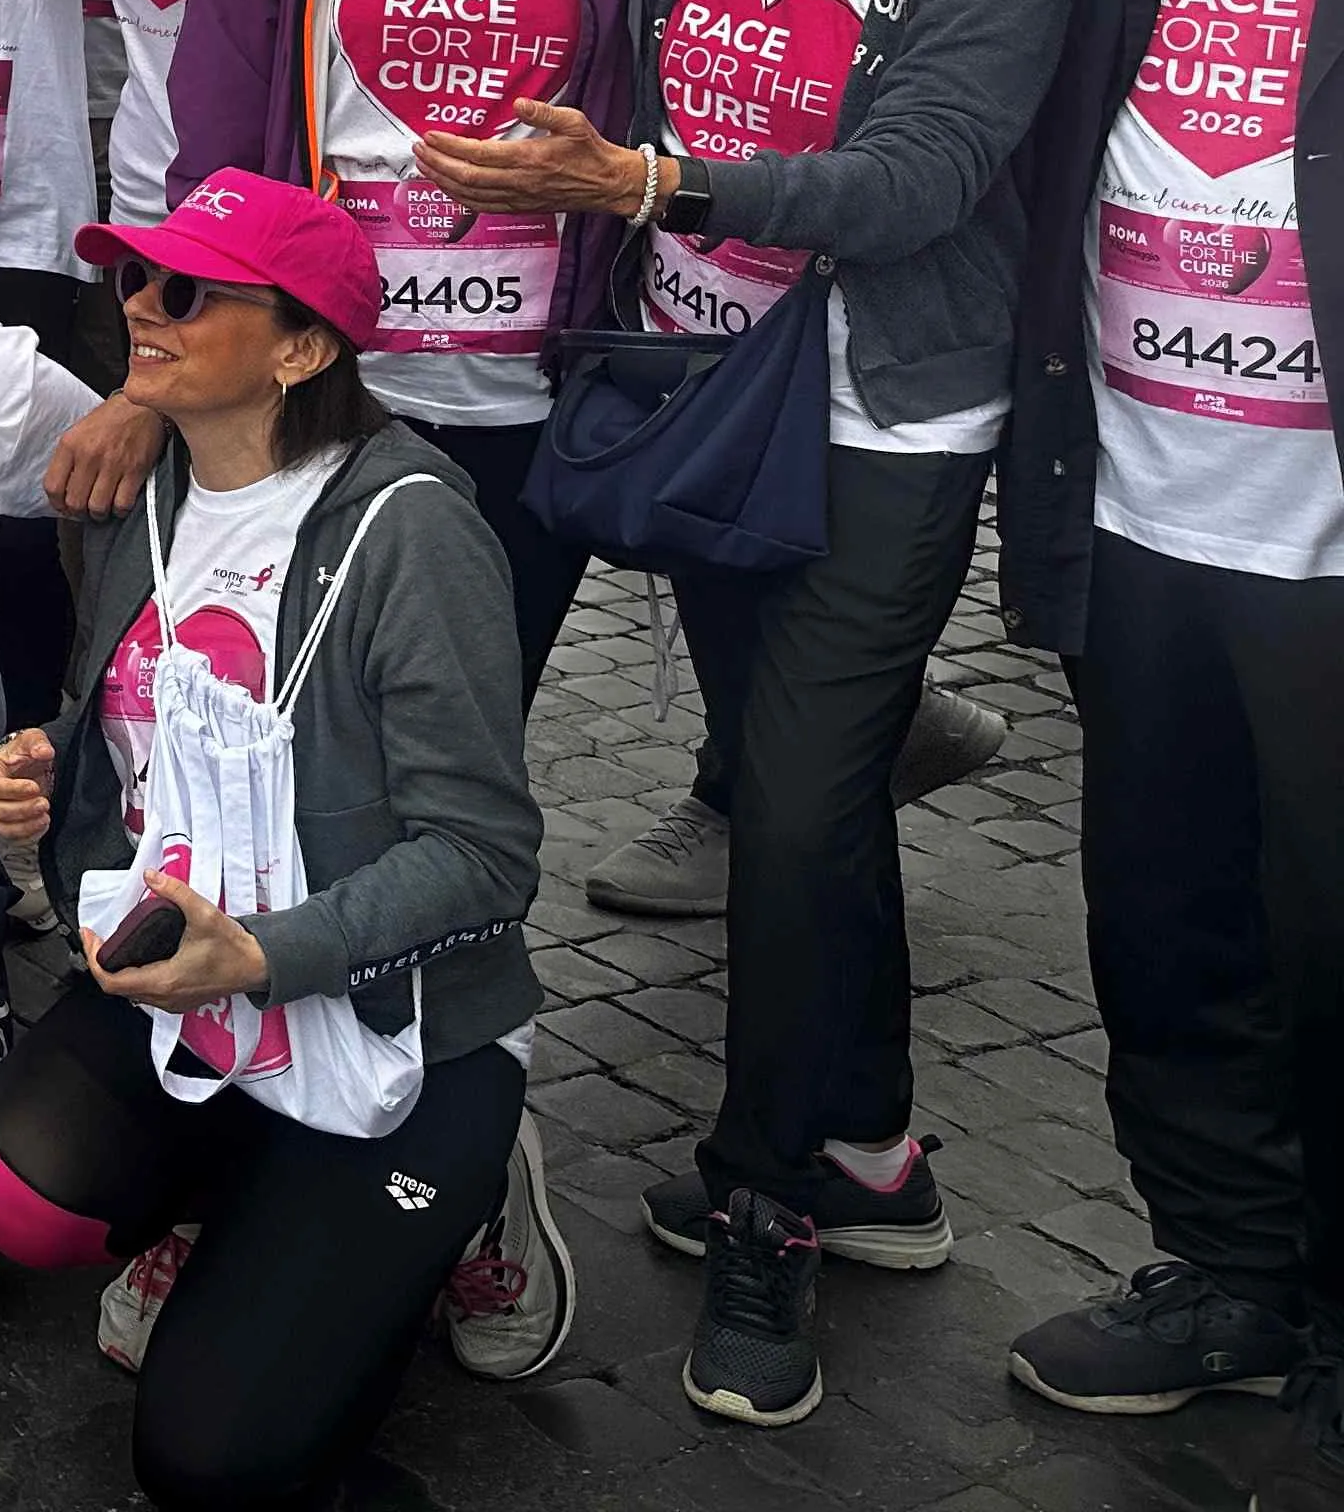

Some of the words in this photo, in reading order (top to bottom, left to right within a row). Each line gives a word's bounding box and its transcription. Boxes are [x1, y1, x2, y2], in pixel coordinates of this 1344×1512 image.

[381, 25, 474, 61] FOR
[485, 29, 569, 72] THE
[678, 2, 791, 63] RACE
[1158, 17, 1239, 58] OR
[1255, 23, 1309, 62] TH
[378, 59, 509, 101] CURE
[665, 38, 740, 89] FOR
[750, 67, 833, 117] THE
[1133, 54, 1290, 106] CURE
[425, 103, 488, 126] 2026
[662, 76, 774, 135] CURE
[1179, 108, 1264, 138] 2026
[690, 129, 758, 162] 2026
[407, 190, 453, 203] RACE
[408, 203, 440, 216] FOR
[445, 203, 472, 216] THE
[1153, 187, 1170, 209] il
[1171, 196, 1231, 216] cuore
[1231, 194, 1279, 223] della
[408, 215, 454, 229] CURE
[1109, 223, 1148, 246] ROMA
[1180, 229, 1234, 248] RACE
[1180, 244, 1221, 261] FOR
[1226, 247, 1258, 265] THE
[1180, 259, 1234, 278] CURE
[654, 252, 753, 337] 84410
[1200, 278, 1230, 289] 2026
[1132, 318, 1320, 382] 84424
[350, 949, 420, 986] UNDER
[390, 1171, 437, 1200] arena
